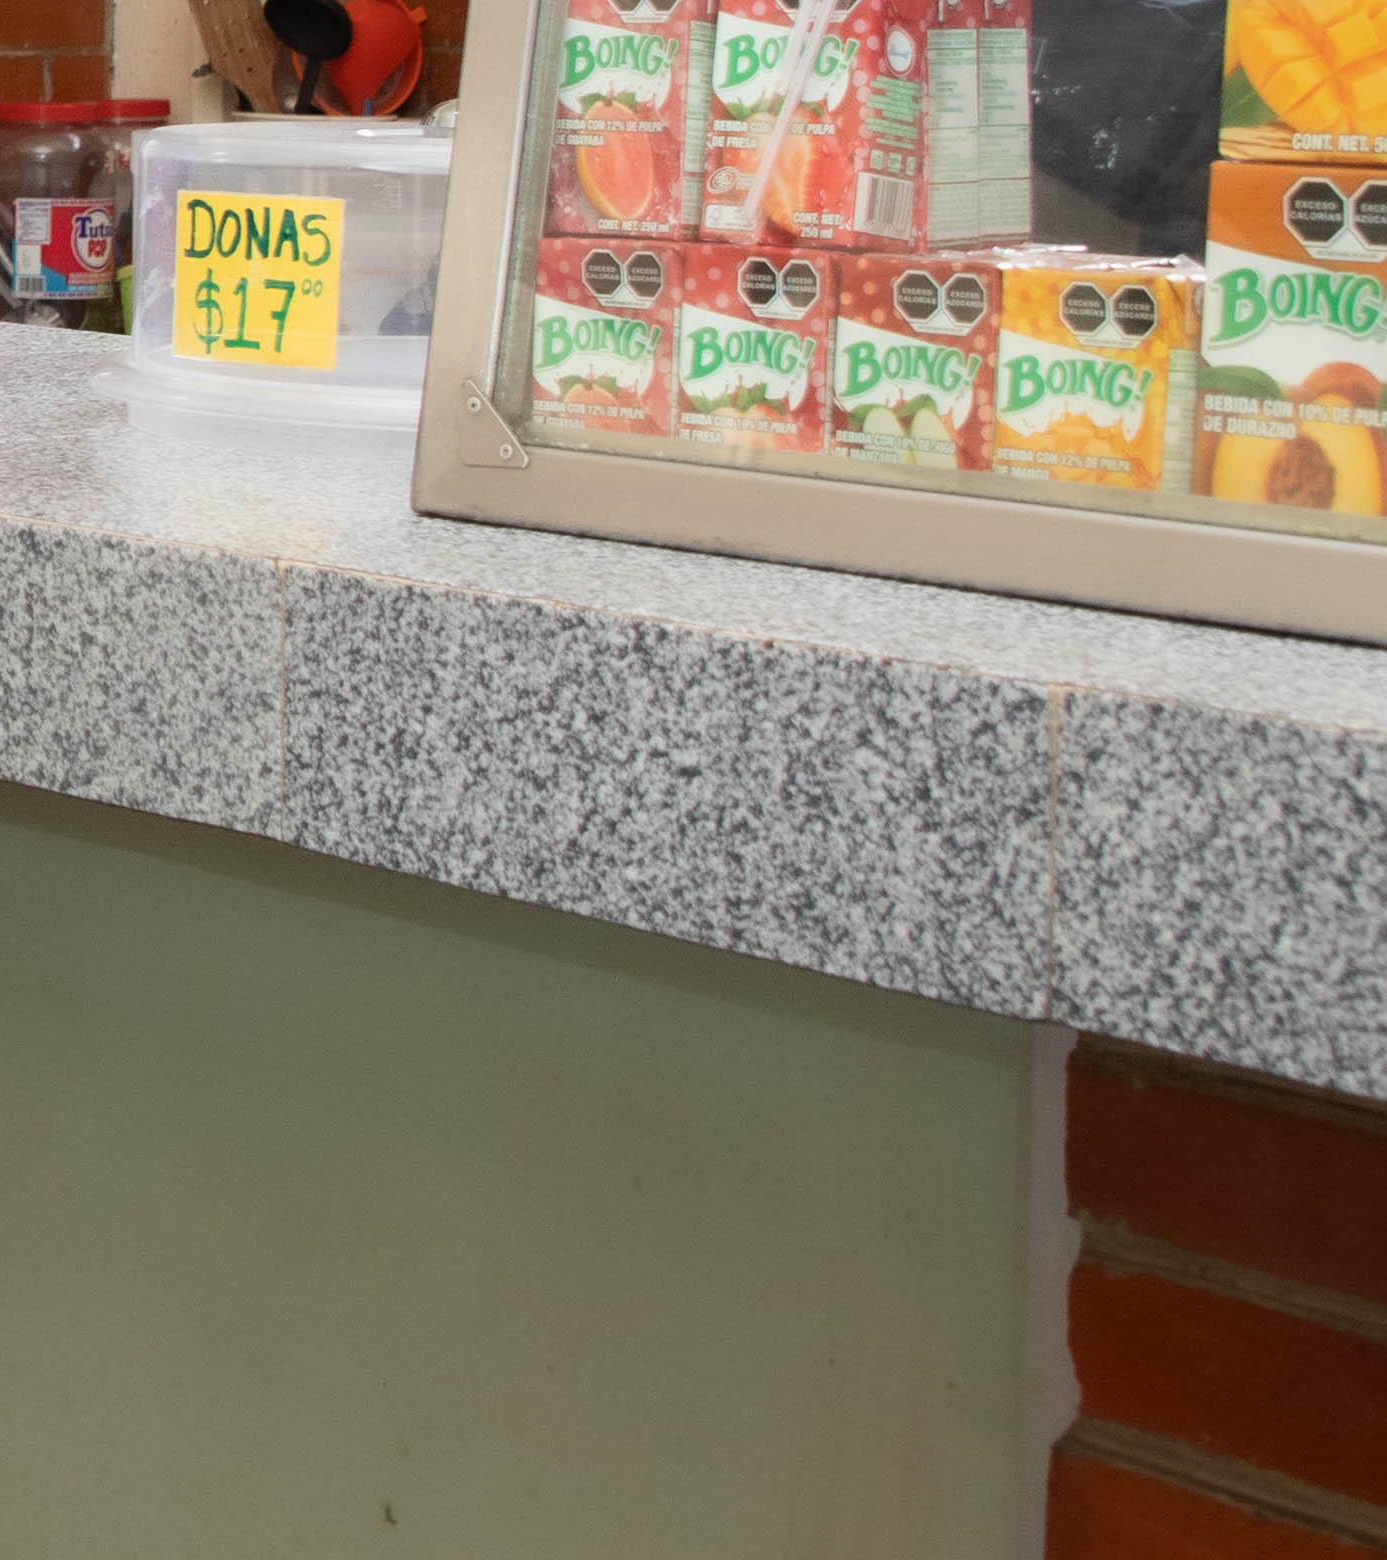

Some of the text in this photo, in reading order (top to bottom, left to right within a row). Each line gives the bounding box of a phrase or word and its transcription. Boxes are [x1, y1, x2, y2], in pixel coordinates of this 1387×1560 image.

[558, 34, 679, 88] BOING!
[717, 32, 860, 90] BOG!
[1292, 133, 1370, 152] CONT. NET.
[185, 199, 331, 266] DONAS
[1211, 268, 1387, 343] BOING
[534, 315, 662, 369] BOING!
[682, 326, 817, 381] BOING!
[838, 341, 982, 397] BOING!
[1000, 355, 1154, 412] BOING!
[1204, 394, 1259, 416] BEBIDA
[1263, 400, 1294, 419] CON
[1333, 408, 1351, 424] DE
[1203, 415, 1297, 439] DE DURAZNO
